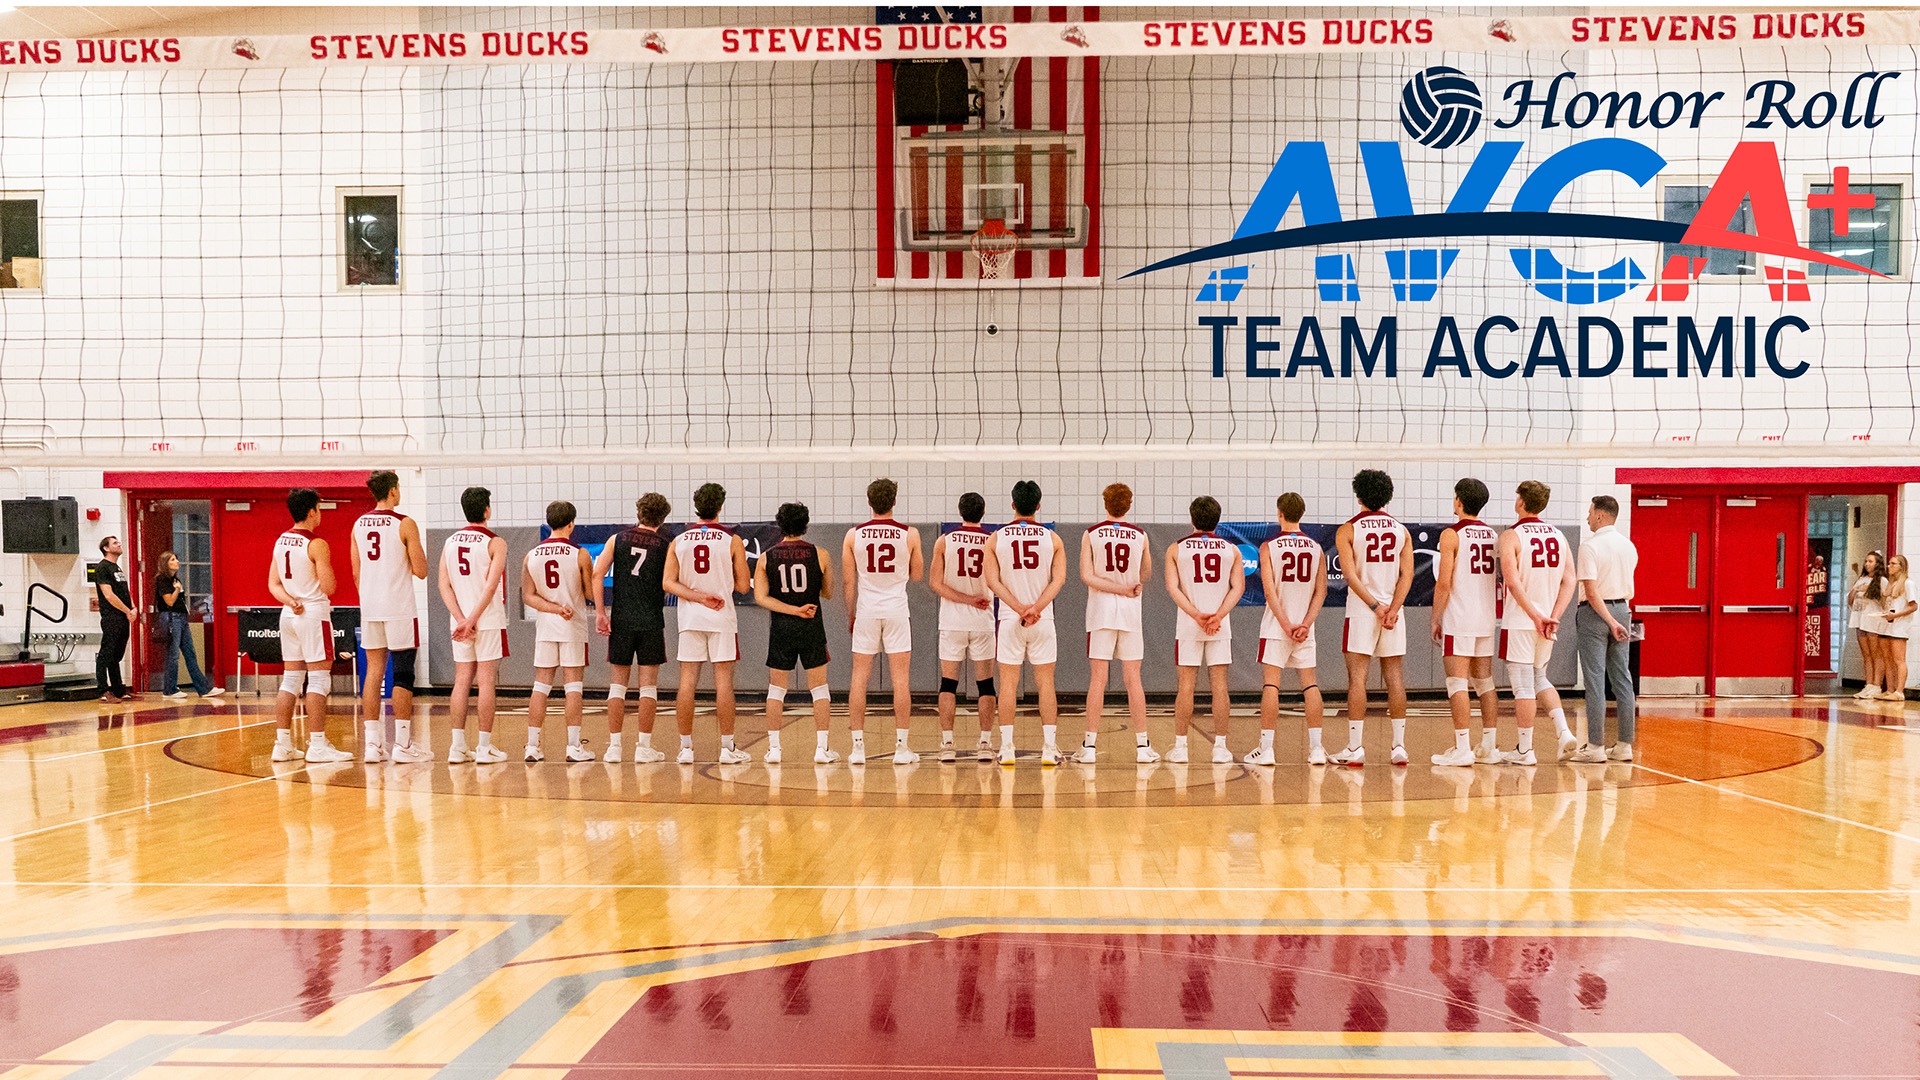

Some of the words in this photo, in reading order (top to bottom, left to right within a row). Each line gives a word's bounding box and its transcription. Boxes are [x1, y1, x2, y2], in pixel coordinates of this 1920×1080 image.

[722, 27, 882, 53] STEVENS
[897, 25, 1007, 50] DUCKS
[1144, 21, 1306, 47] STEVENS
[1322, 18, 1433, 45] DUCKS
[1572, 15, 1737, 42] STEVENS
[1752, 12, 1865, 40] DUCKS
[76, 38, 181, 63] DUCKS
[310, 33, 467, 60] STEVENS
[482, 31, 588, 57] DUCKS
[359, 516, 392, 527] STEVENS
[683, 531, 723, 541] STEVENS
[861, 528, 901, 539] STEVENS
[1004, 527, 1044, 537] STEVENS
[1098, 528, 1136, 540] STEVENS
[1360, 519, 1397, 530] STEVENS
[367, 531, 380, 561] 3
[451, 533, 484, 543] STEVENS
[534, 545, 571, 557] STEVENS
[952, 533, 989, 545] STEVEN
[1185, 539, 1226, 549] STEVENS
[1276, 538, 1314, 549] STEVENS
[1365, 532, 1396, 562] 22
[1530, 537, 1559, 568] 28
[285, 550, 292, 579] 1
[458, 546, 470, 576] 5
[630, 546, 648, 576] 7
[693, 544, 710, 574] 8
[866, 543, 895, 573] 12
[957, 547, 984, 578] 13
[1011, 540, 1039, 570] 15
[1104, 542, 1130, 573] 18
[1192, 553, 1221, 583] 19
[1281, 551, 1312, 582] 20
[1470, 543, 1494, 574] 25
[545, 559, 560, 589] 6
[778, 563, 807, 593] 10
